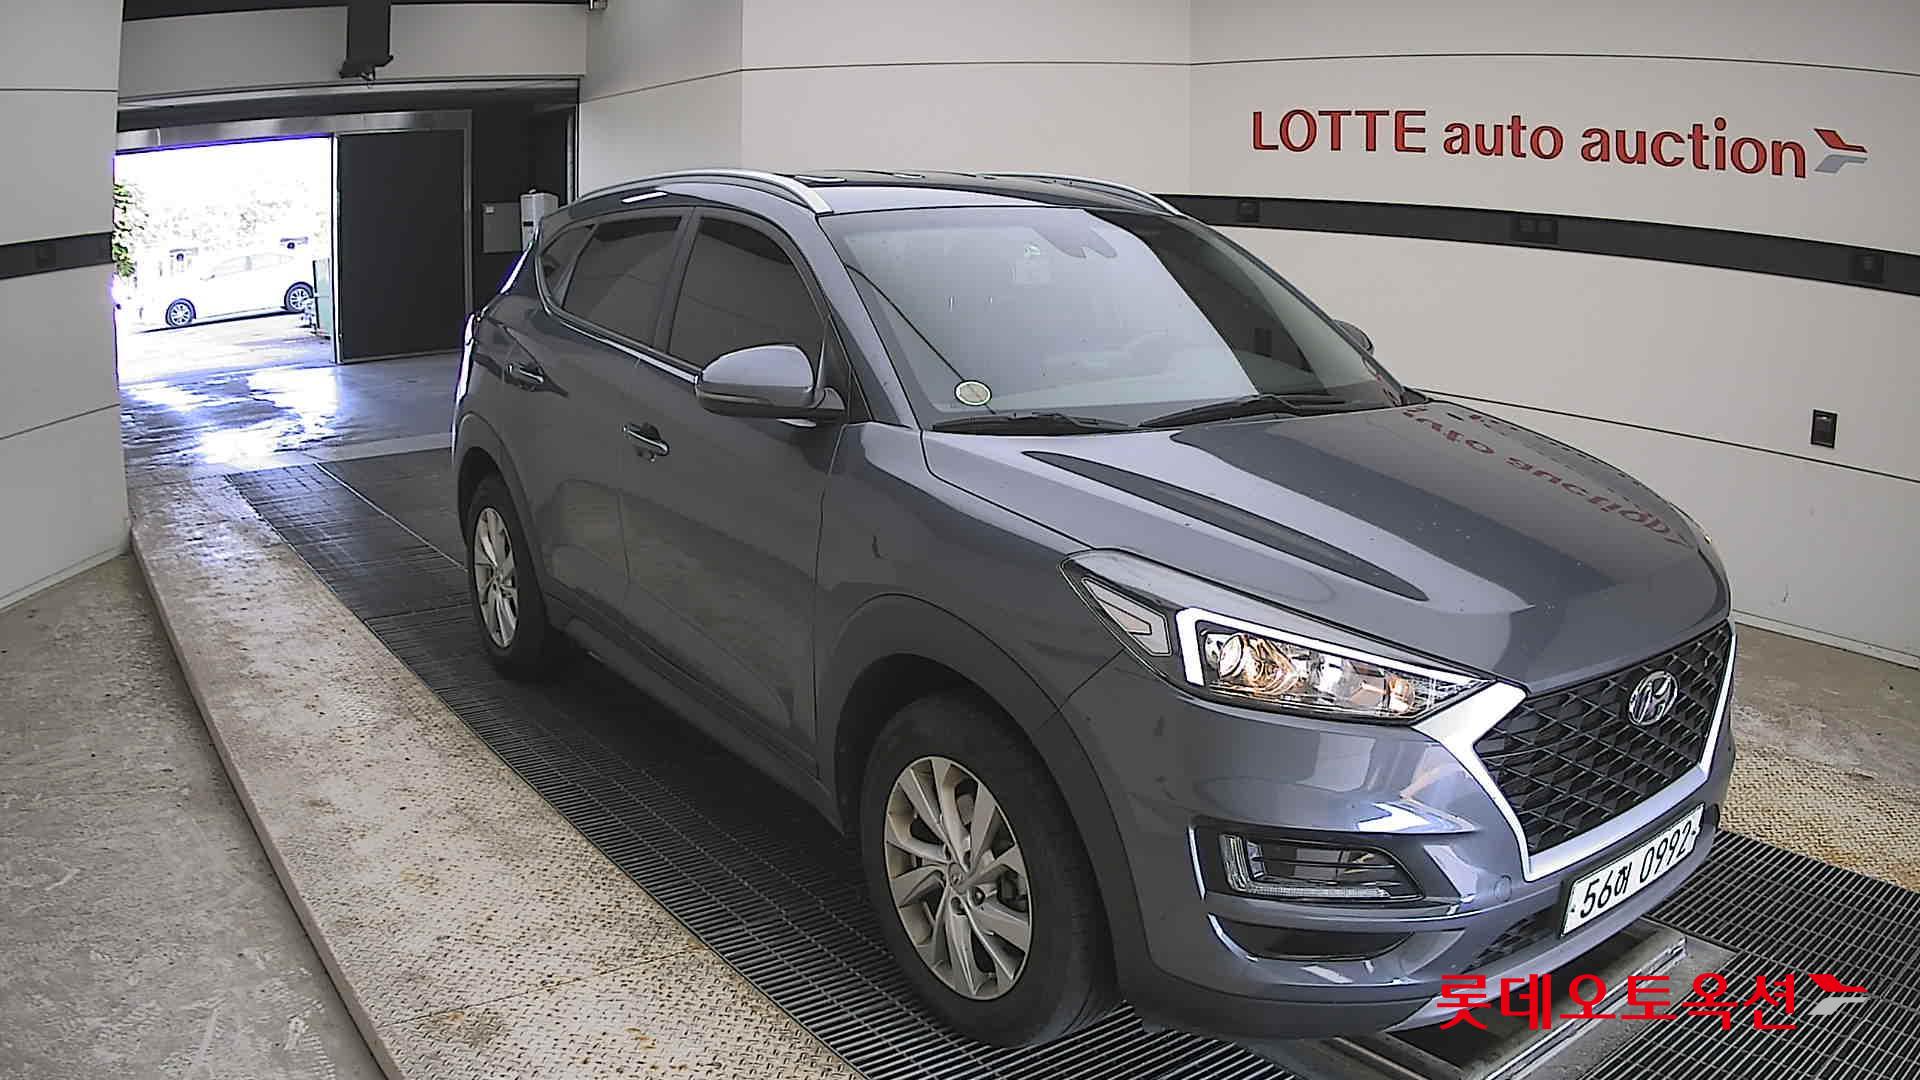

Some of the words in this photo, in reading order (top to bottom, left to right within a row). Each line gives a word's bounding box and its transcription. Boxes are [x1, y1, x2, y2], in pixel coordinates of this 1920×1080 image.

[1252, 109, 1427, 153] LOTTE
[1443, 115, 1564, 160] auto
[1580, 116, 1807, 179] auction
[1639, 820, 1692, 884] 0992
